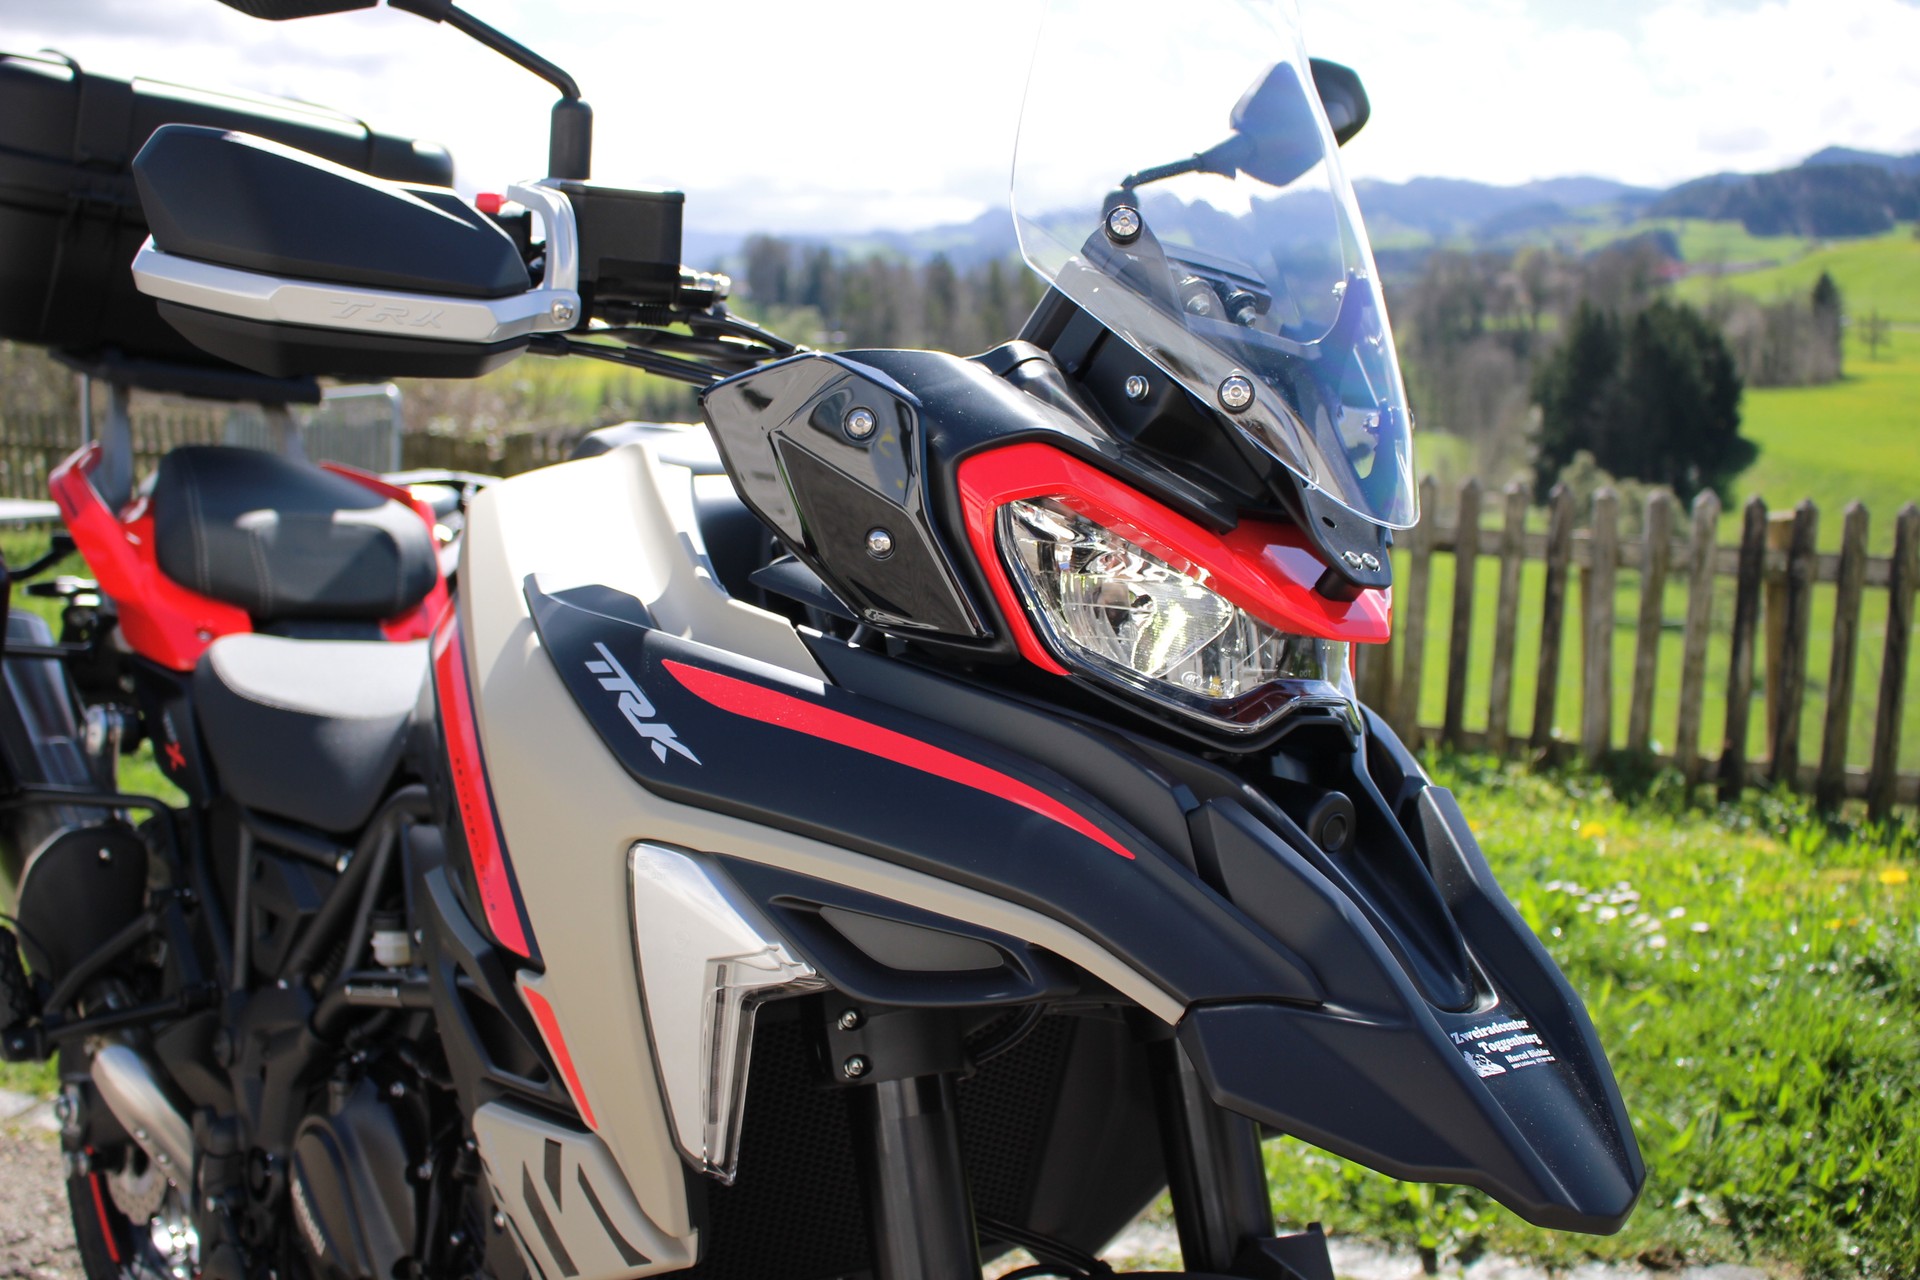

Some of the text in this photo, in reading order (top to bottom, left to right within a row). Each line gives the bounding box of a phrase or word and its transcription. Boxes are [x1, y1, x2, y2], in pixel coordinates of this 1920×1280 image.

[328, 297, 445, 329] TRK
[584, 642, 703, 766] TRK
[1450, 1019, 1530, 1045] Zweiradcenter
[1477, 1033, 1543, 1054] Toggenburg
[1504, 1051, 1529, 1063] Marcel
